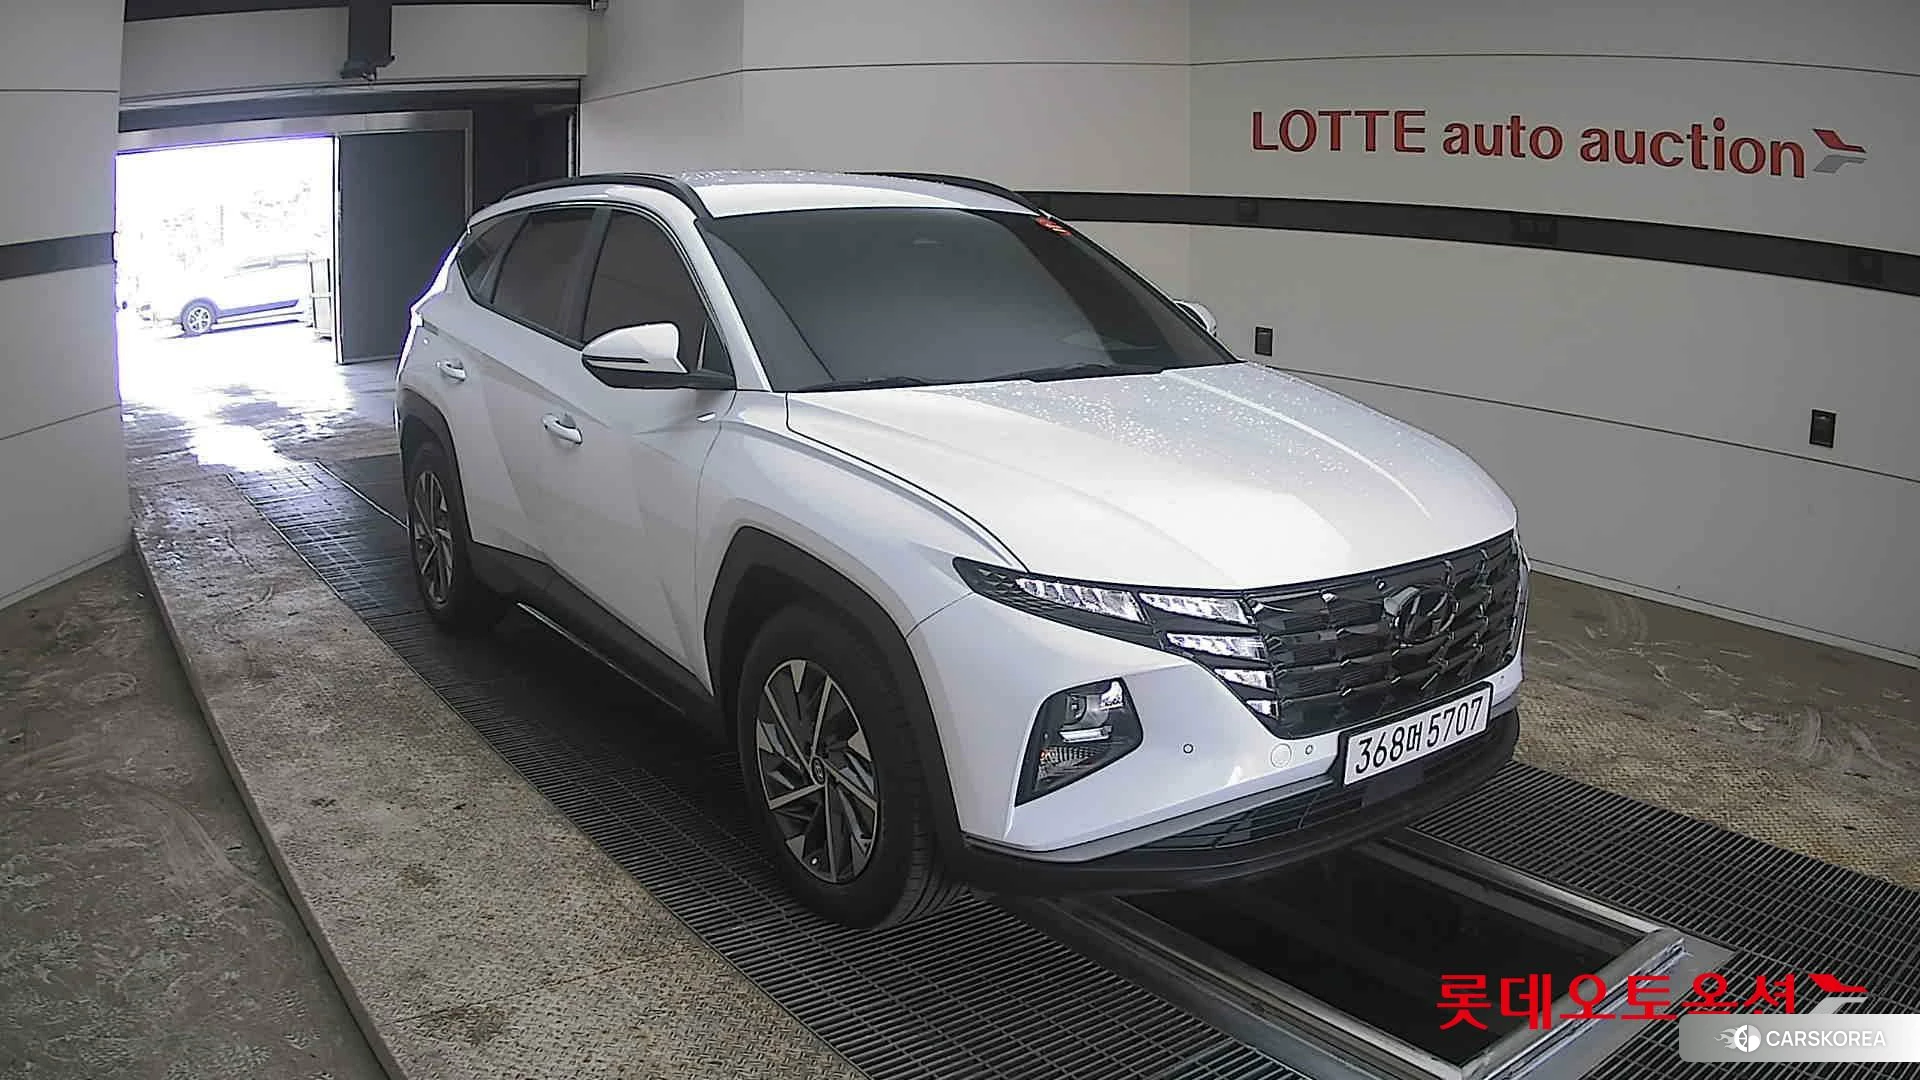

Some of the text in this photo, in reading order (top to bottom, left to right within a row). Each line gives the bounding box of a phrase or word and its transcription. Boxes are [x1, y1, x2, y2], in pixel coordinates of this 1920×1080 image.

[1252, 109, 1806, 179] LOTTE auto auction
[1354, 695, 1484, 774] 368머 5707
